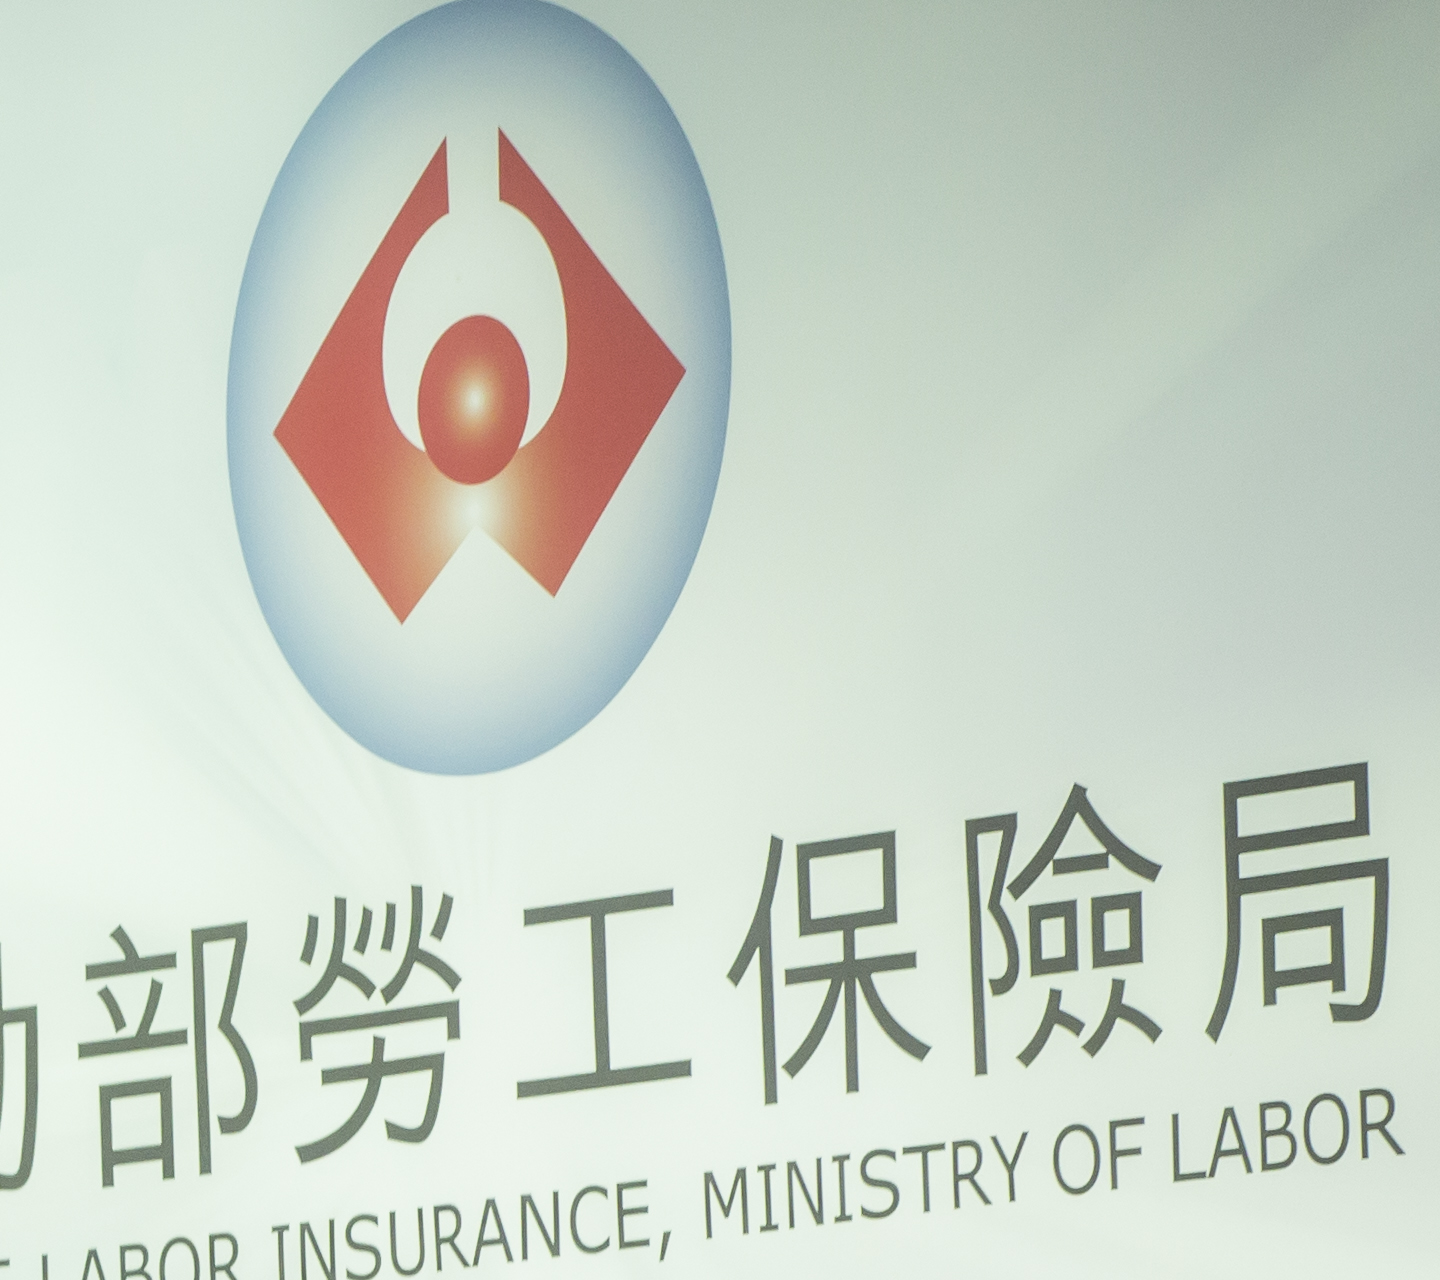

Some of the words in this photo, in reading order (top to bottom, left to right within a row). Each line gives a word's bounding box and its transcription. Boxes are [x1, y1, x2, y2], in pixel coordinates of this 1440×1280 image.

[701, 1129, 1030, 1241] MINISTRY
[1050, 1114, 1147, 1198] OF
[1169, 1085, 1407, 1185] LABOR
